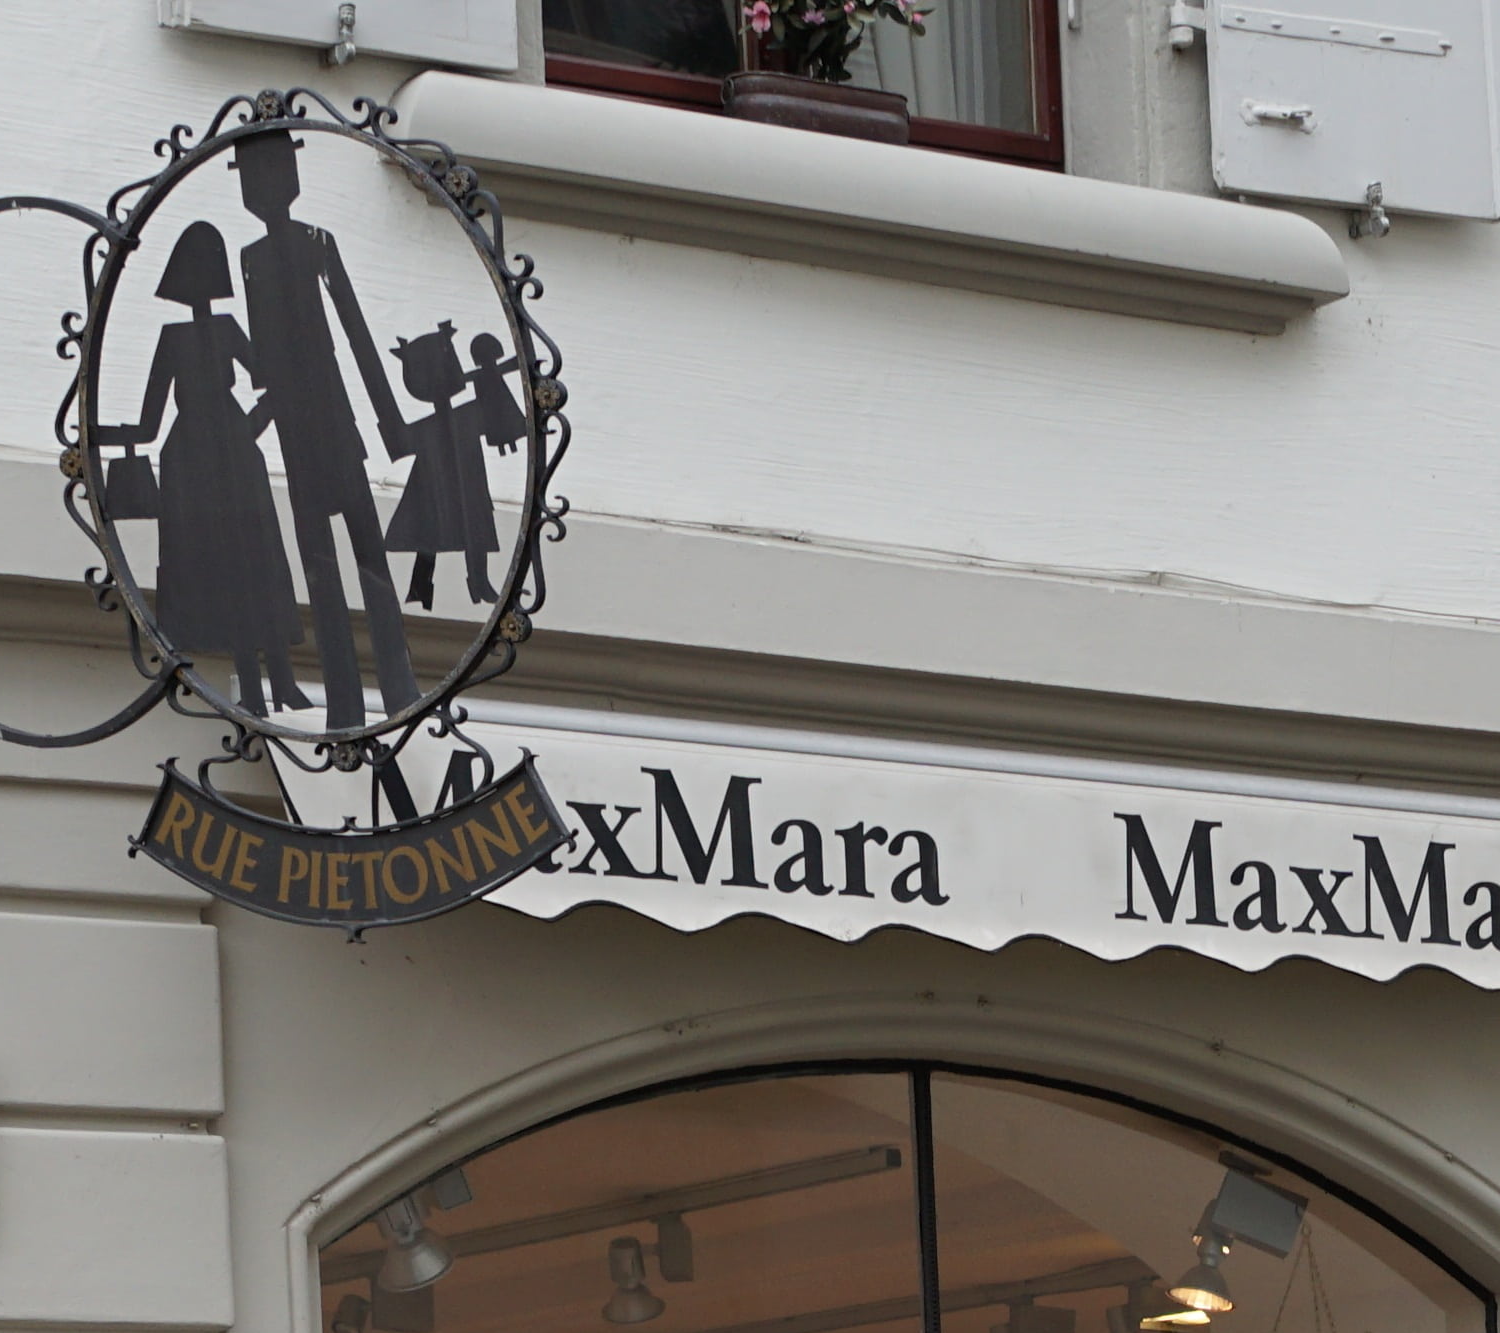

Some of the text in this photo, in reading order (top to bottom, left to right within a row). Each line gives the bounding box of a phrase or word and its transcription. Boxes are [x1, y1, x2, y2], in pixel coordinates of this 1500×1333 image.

[153, 781, 550, 911] RUE PIETONNE
[366, 742, 951, 906] MxMara
